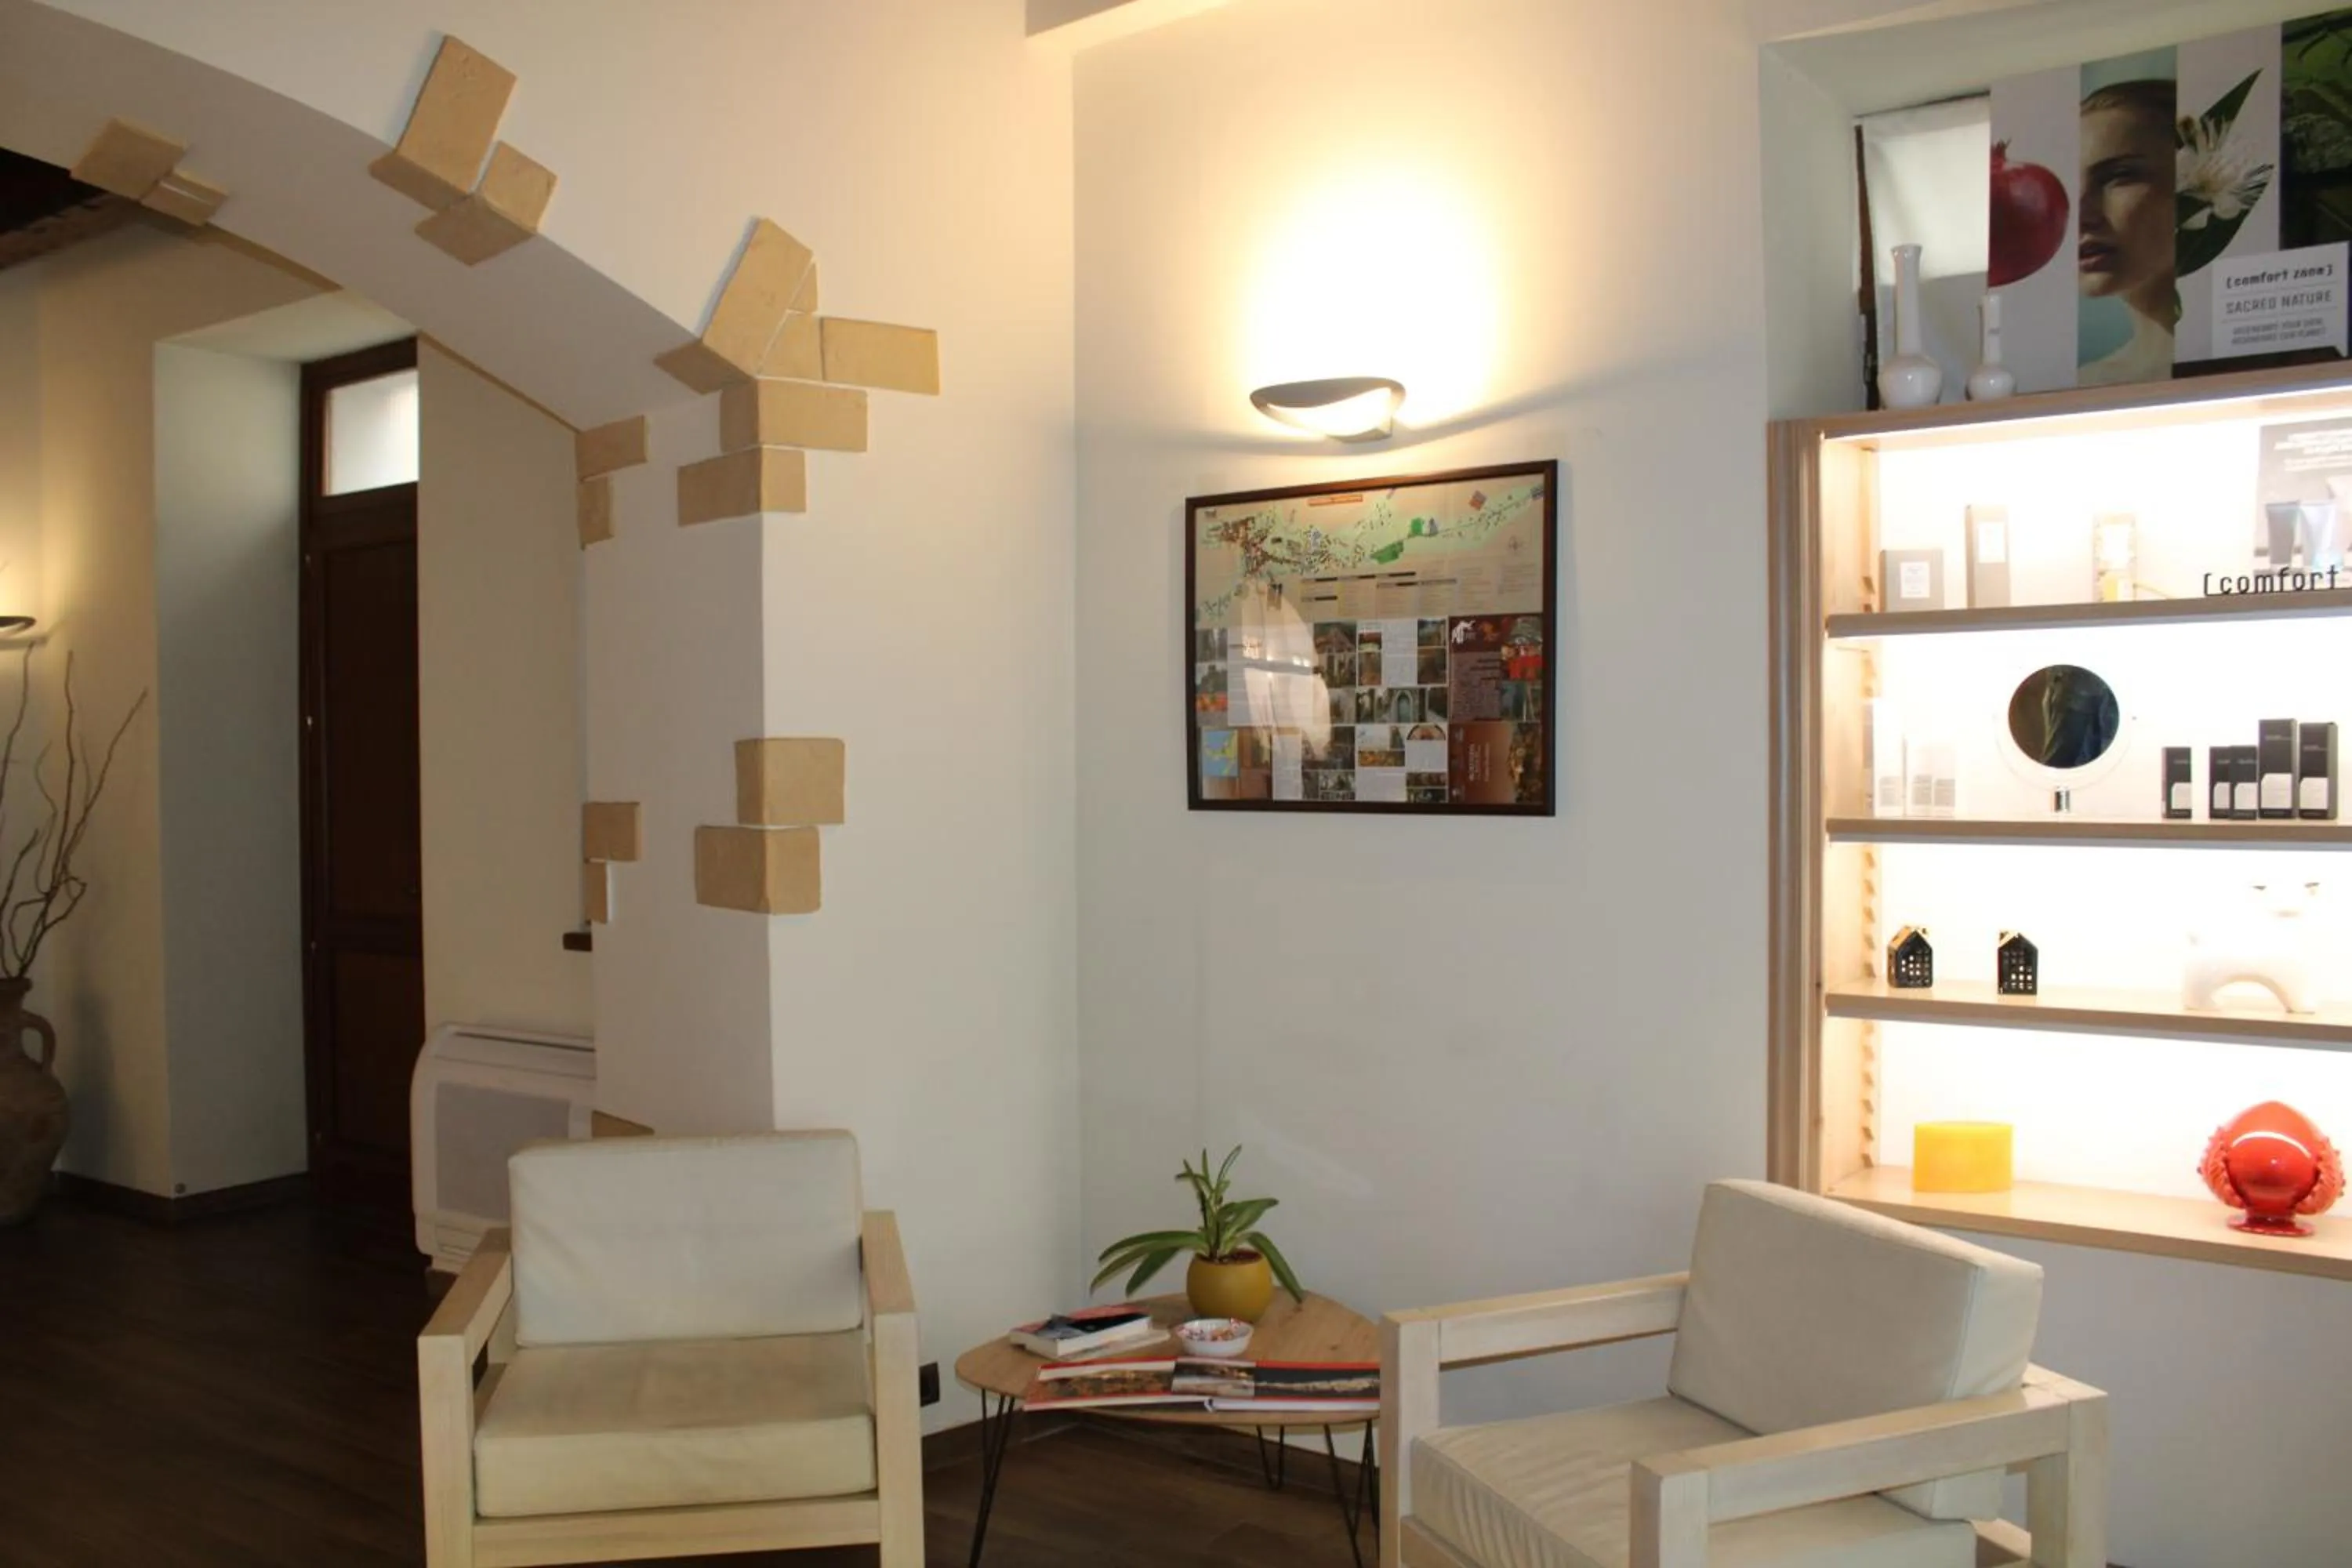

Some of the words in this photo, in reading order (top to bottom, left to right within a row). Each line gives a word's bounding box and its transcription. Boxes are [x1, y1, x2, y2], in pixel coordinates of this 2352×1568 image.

[2226, 269, 2288, 289] [comfort
[2293, 263, 2333, 281] zone]
[2225, 296, 2277, 314] SACRED
[2281, 289, 2332, 308] NATURE
[2203, 564, 2339, 597] [comfort
